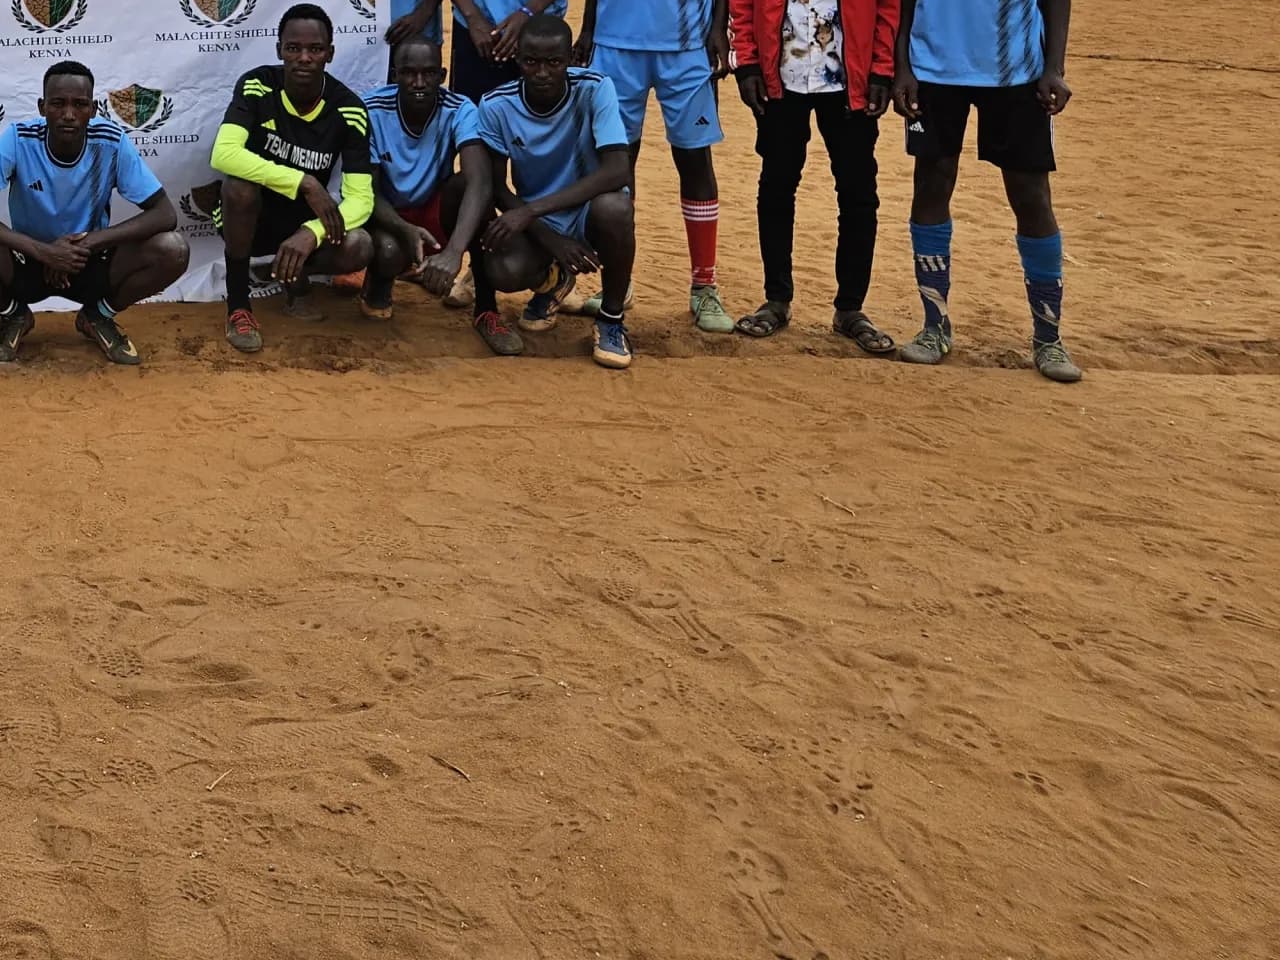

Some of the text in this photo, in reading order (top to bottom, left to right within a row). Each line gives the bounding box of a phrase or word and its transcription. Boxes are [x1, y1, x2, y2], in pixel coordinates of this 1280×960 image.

[65, 34, 113, 44] SHIELD
[155, 31, 232, 42] MALACHITE
[198, 43, 241, 53] KENYA
[29, 49, 72, 58] KENYA
[152, 134, 200, 145] SHIELD
[263, 132, 333, 171] TEAM MEMUSI
